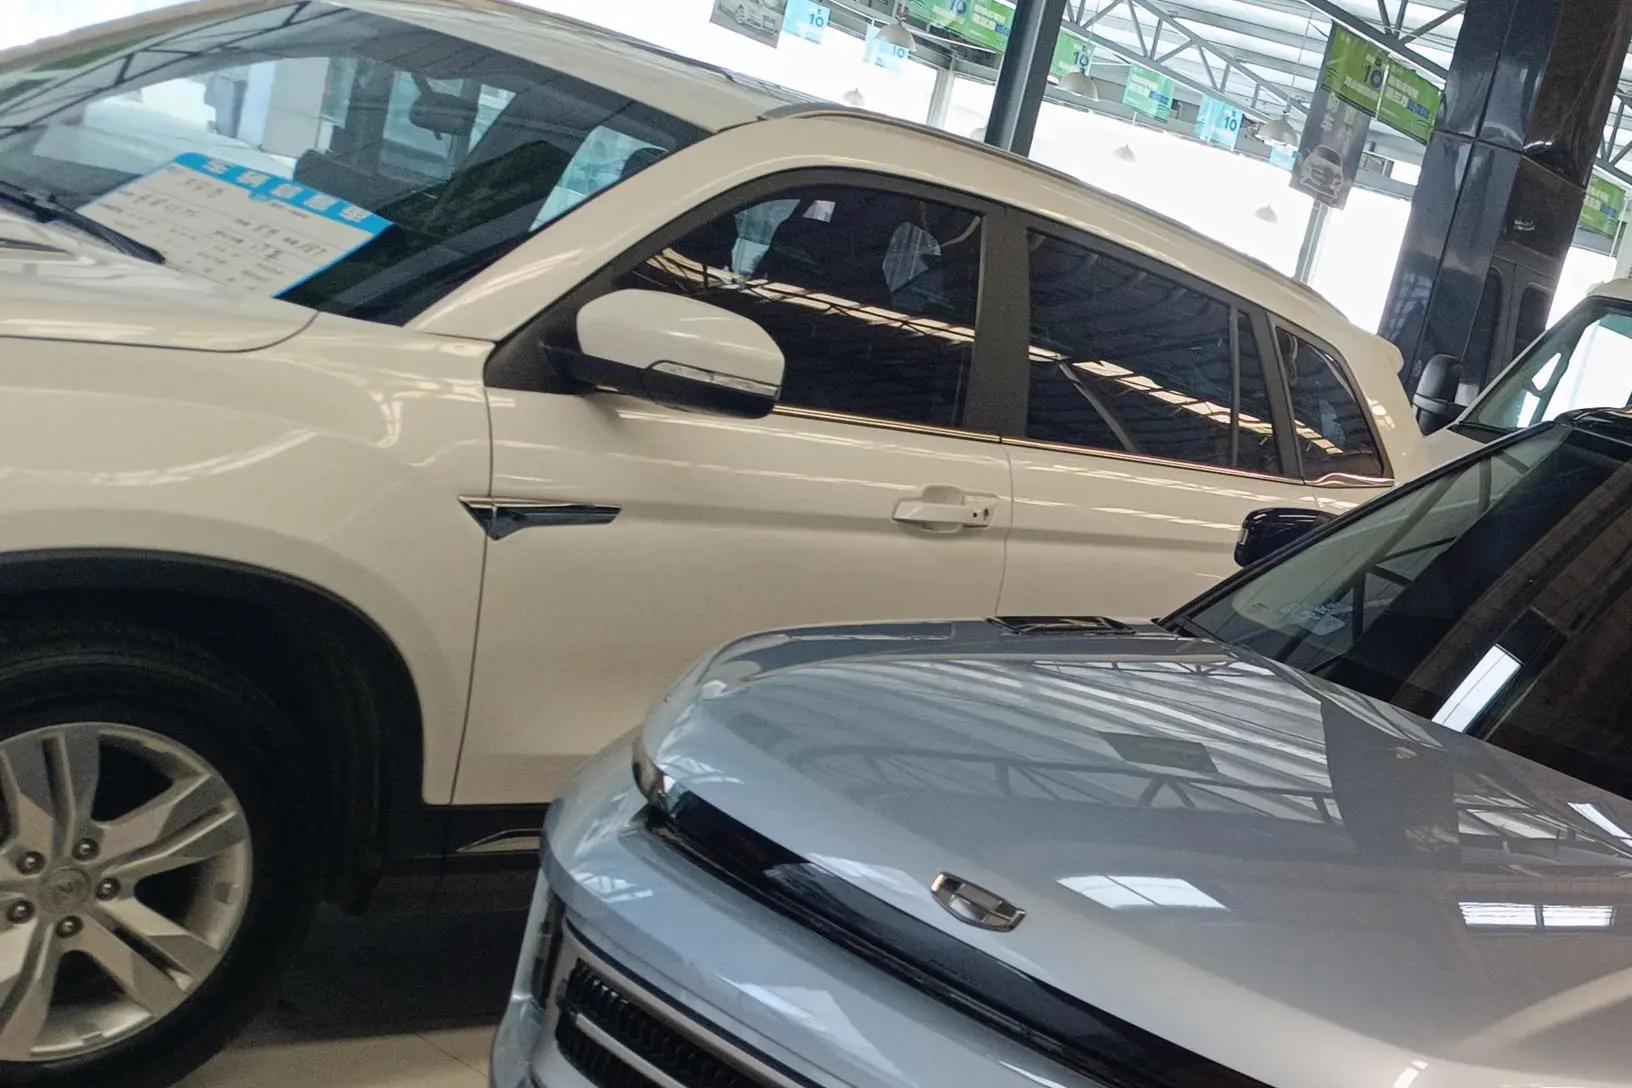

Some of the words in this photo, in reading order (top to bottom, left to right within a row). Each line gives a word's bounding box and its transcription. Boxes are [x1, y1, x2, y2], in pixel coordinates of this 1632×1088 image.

[808, 13, 824, 28] 10
[1073, 51, 1089, 67] 10
[1363, 64, 1384, 89] 10
[1224, 116, 1237, 131] 10
